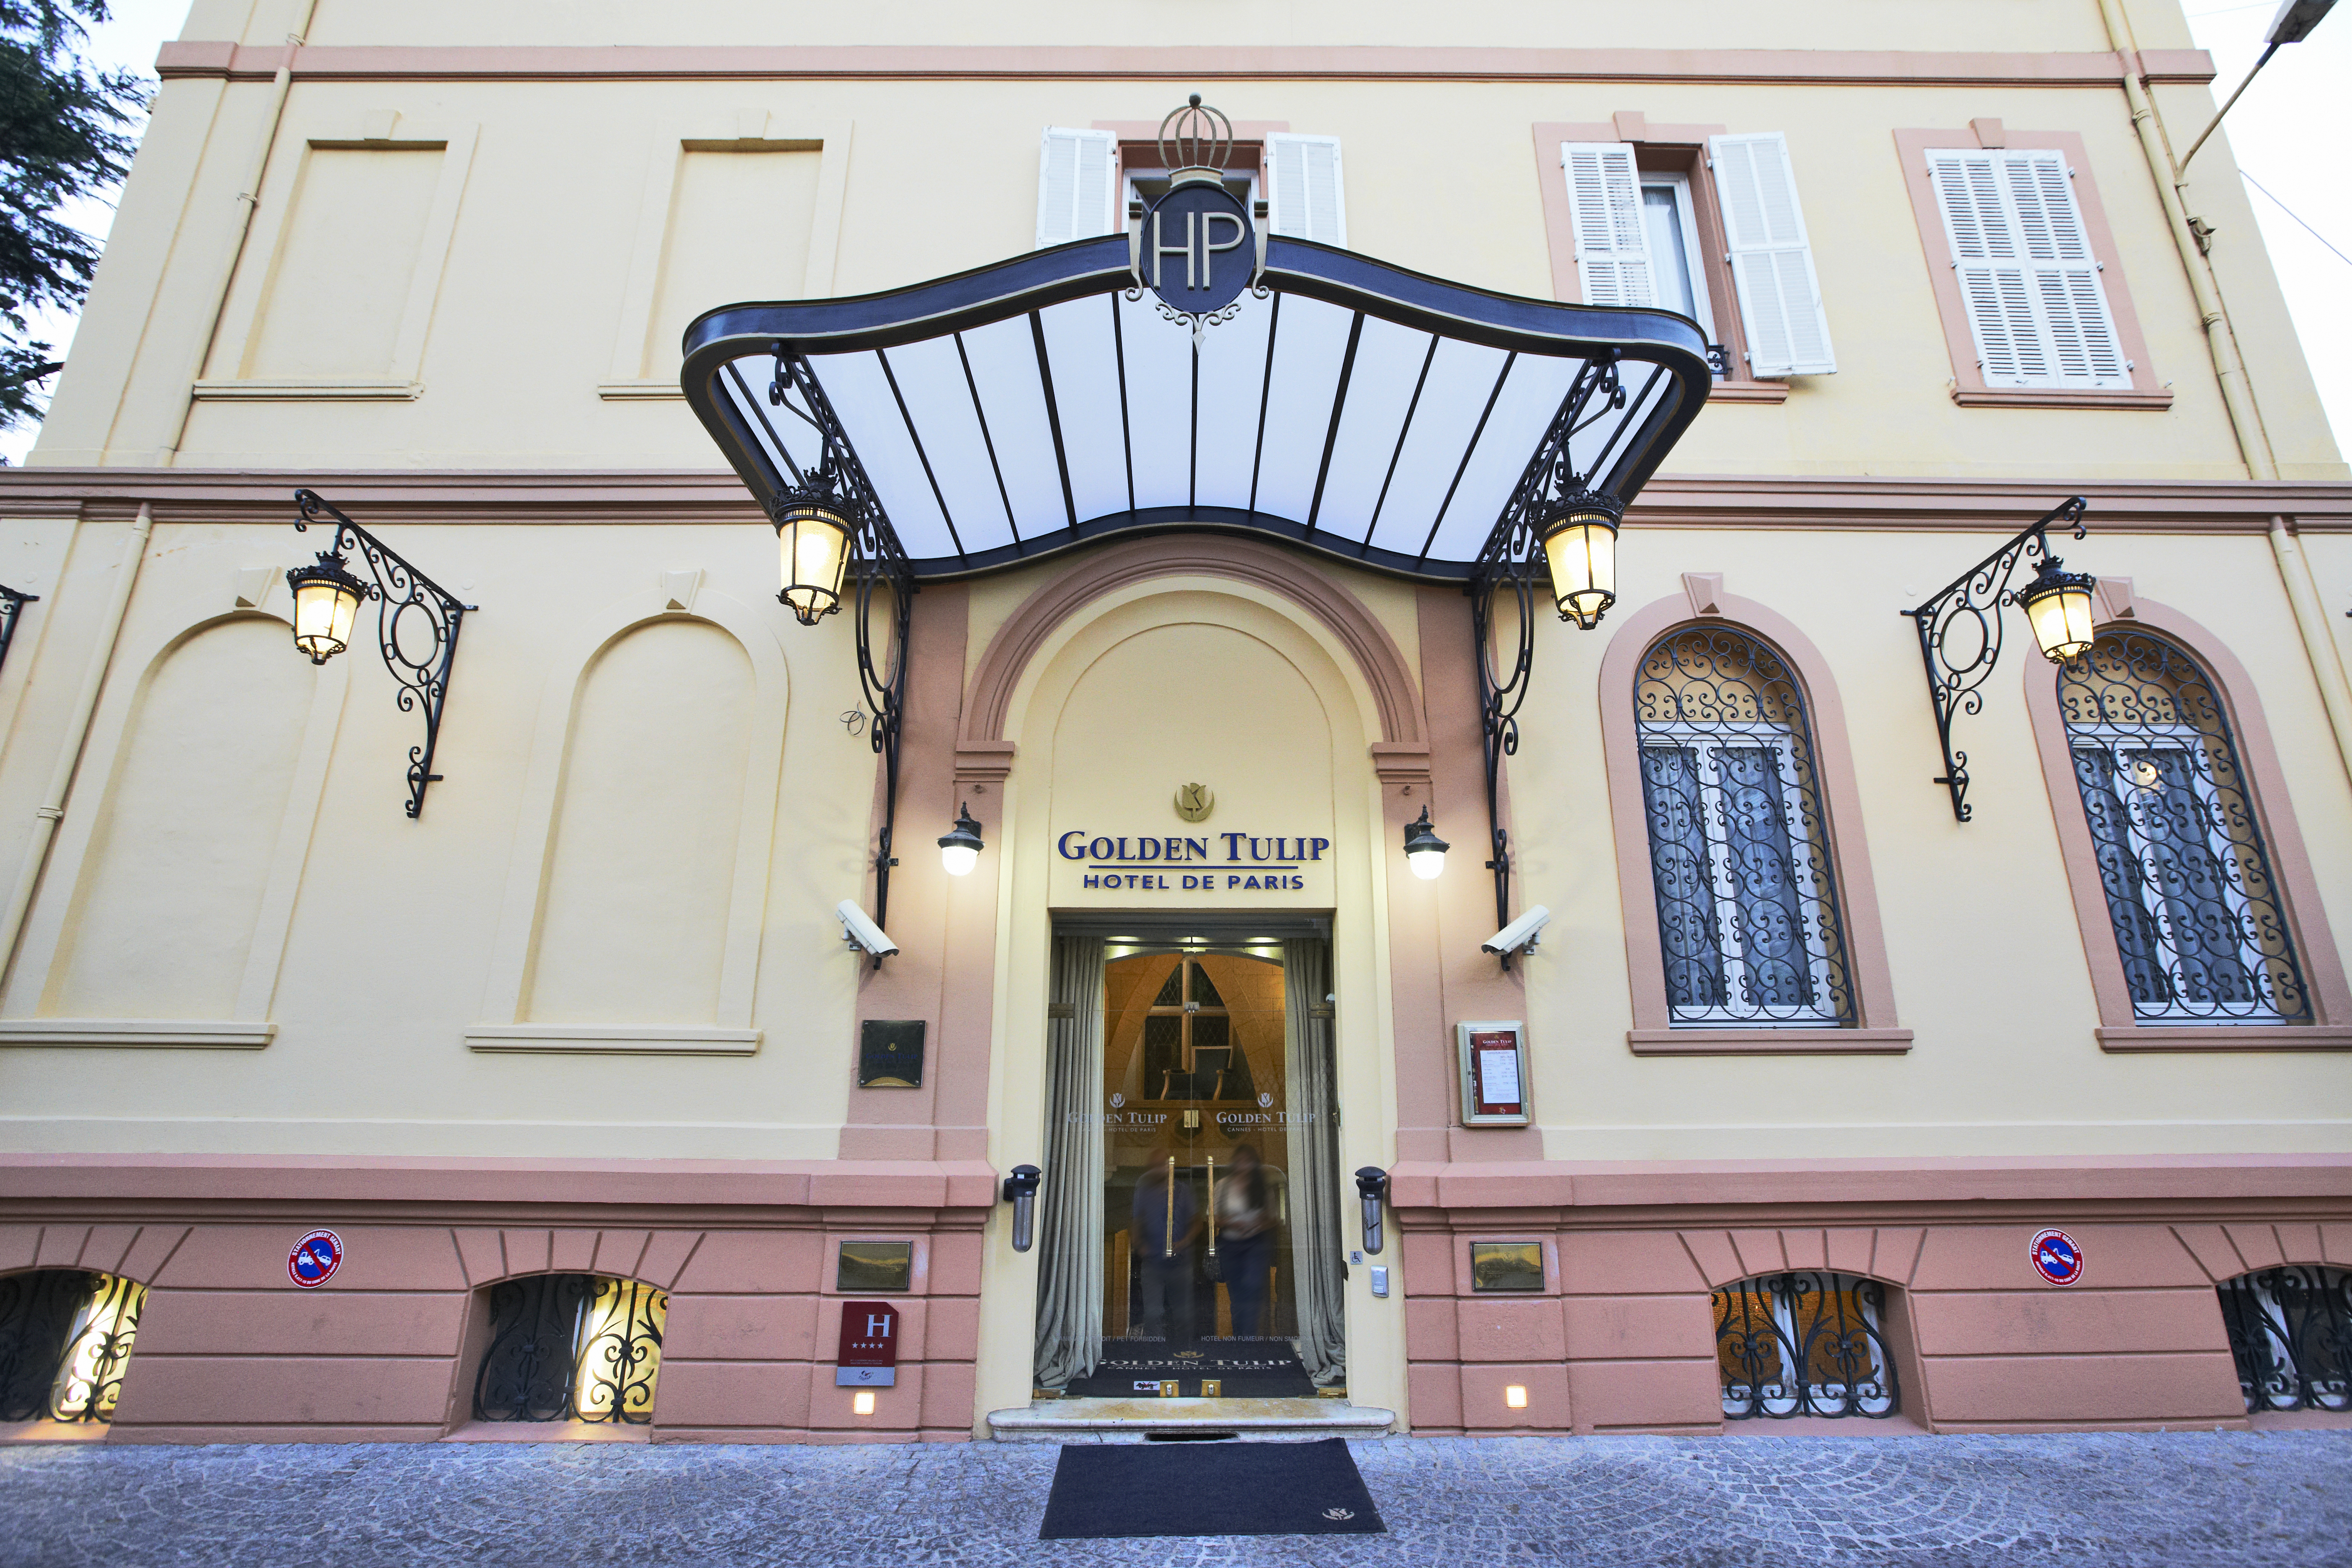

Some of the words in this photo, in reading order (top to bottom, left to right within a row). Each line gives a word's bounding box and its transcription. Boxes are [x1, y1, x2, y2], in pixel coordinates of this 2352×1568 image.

[1153, 211, 1245, 290] HP
[1058, 831, 1209, 861] GOLDEN
[1220, 833, 1330, 861] TULIP
[1083, 874, 1169, 889] HOTEL
[1183, 875, 1214, 889] DE
[1228, 875, 1304, 890] PARIS
[1068, 1112, 1122, 1123] GOEN
[1127, 1112, 1167, 1123] TULIP
[1216, 1112, 1271, 1123] GOLDEN
[1276, 1112, 1316, 1123] TULIP
[292, 1232, 331, 1256] STATIONNEMENT
[2032, 1231, 2062, 1255] STATIONNEMENT
[2062, 1235, 2080, 1253] GENANT
[864, 1314, 893, 1337] H
